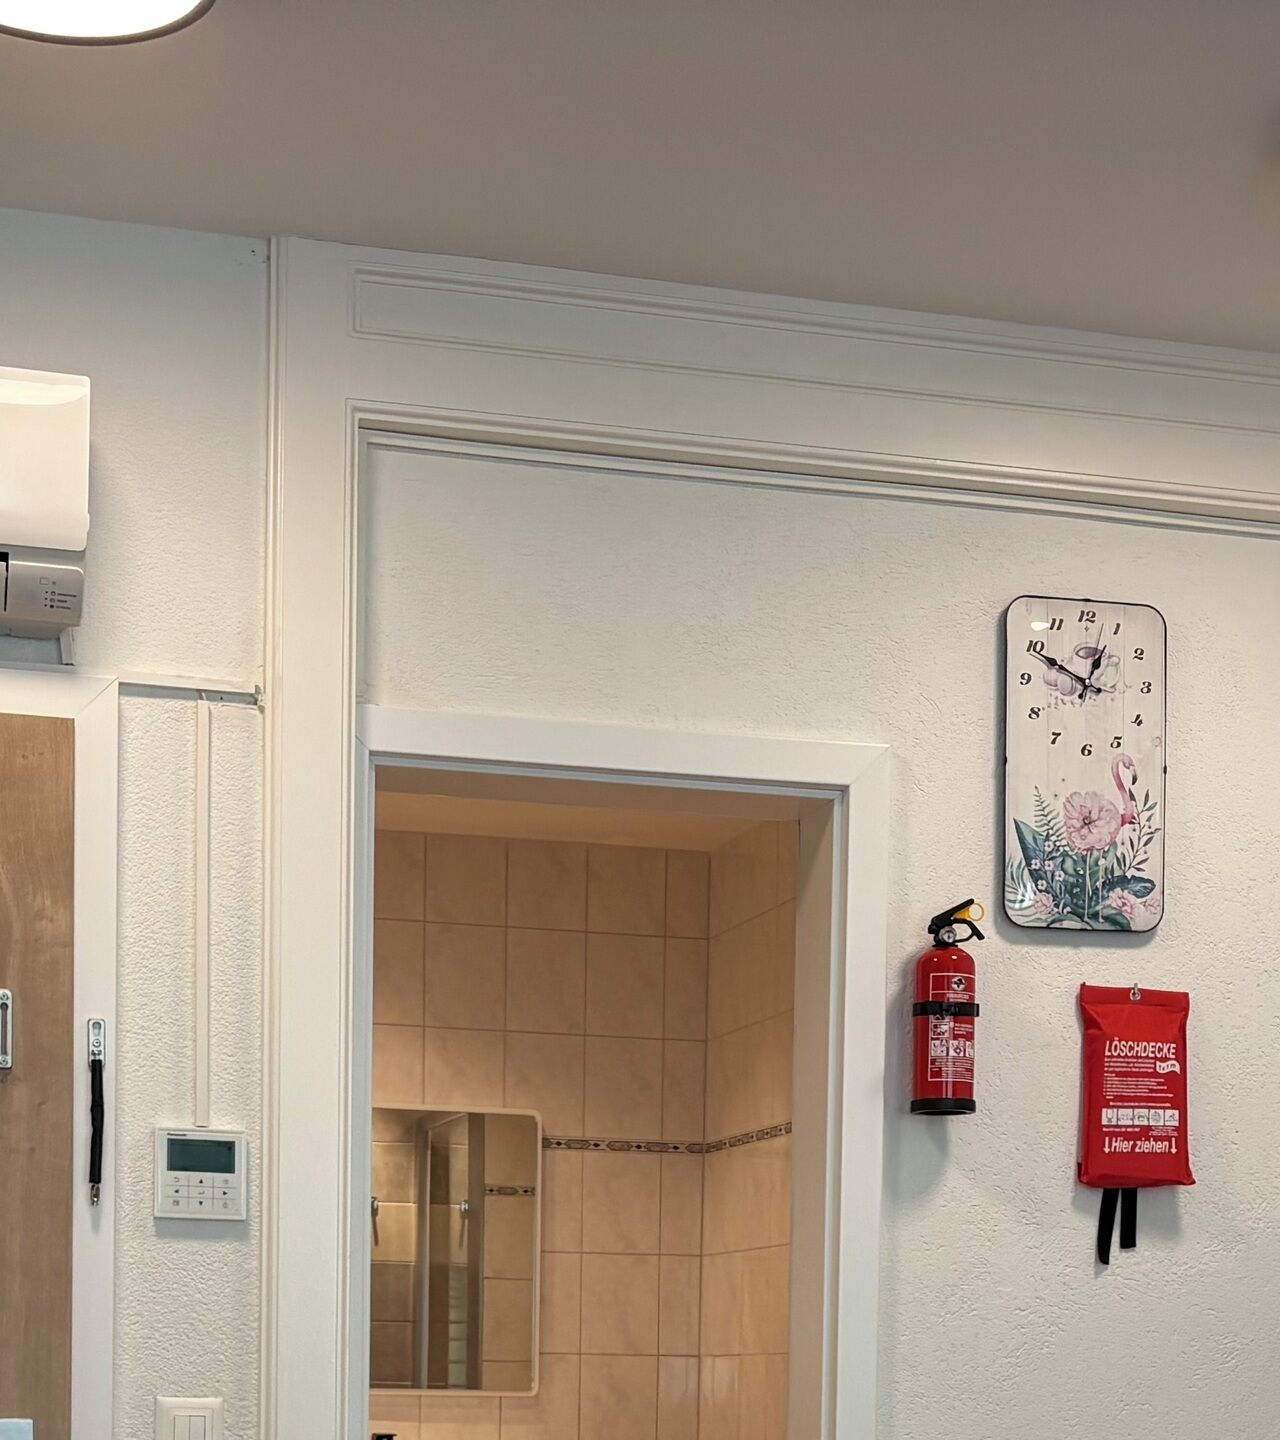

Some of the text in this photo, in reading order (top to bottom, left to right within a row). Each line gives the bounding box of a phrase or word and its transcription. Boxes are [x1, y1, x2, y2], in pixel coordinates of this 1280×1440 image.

[1077, 610, 1097, 624] 12
[1049, 618, 1064, 631] 11
[1113, 623, 1121, 635] 1
[1026, 640, 1045, 653] 10
[1132, 647, 1145, 660] 2
[1020, 672, 1032, 685] 9
[1140, 681, 1152, 694] 3
[1028, 706, 1041, 720] 8
[1131, 714, 1144, 727] 4
[1051, 731, 1062, 745] 7
[1110, 736, 1123, 749] 5
[1080, 743, 1093, 756] 6
[1104, 1036, 1177, 1059] LÖSCHDECKE
[1111, 1137, 1170, 1153] Hier ziehen
